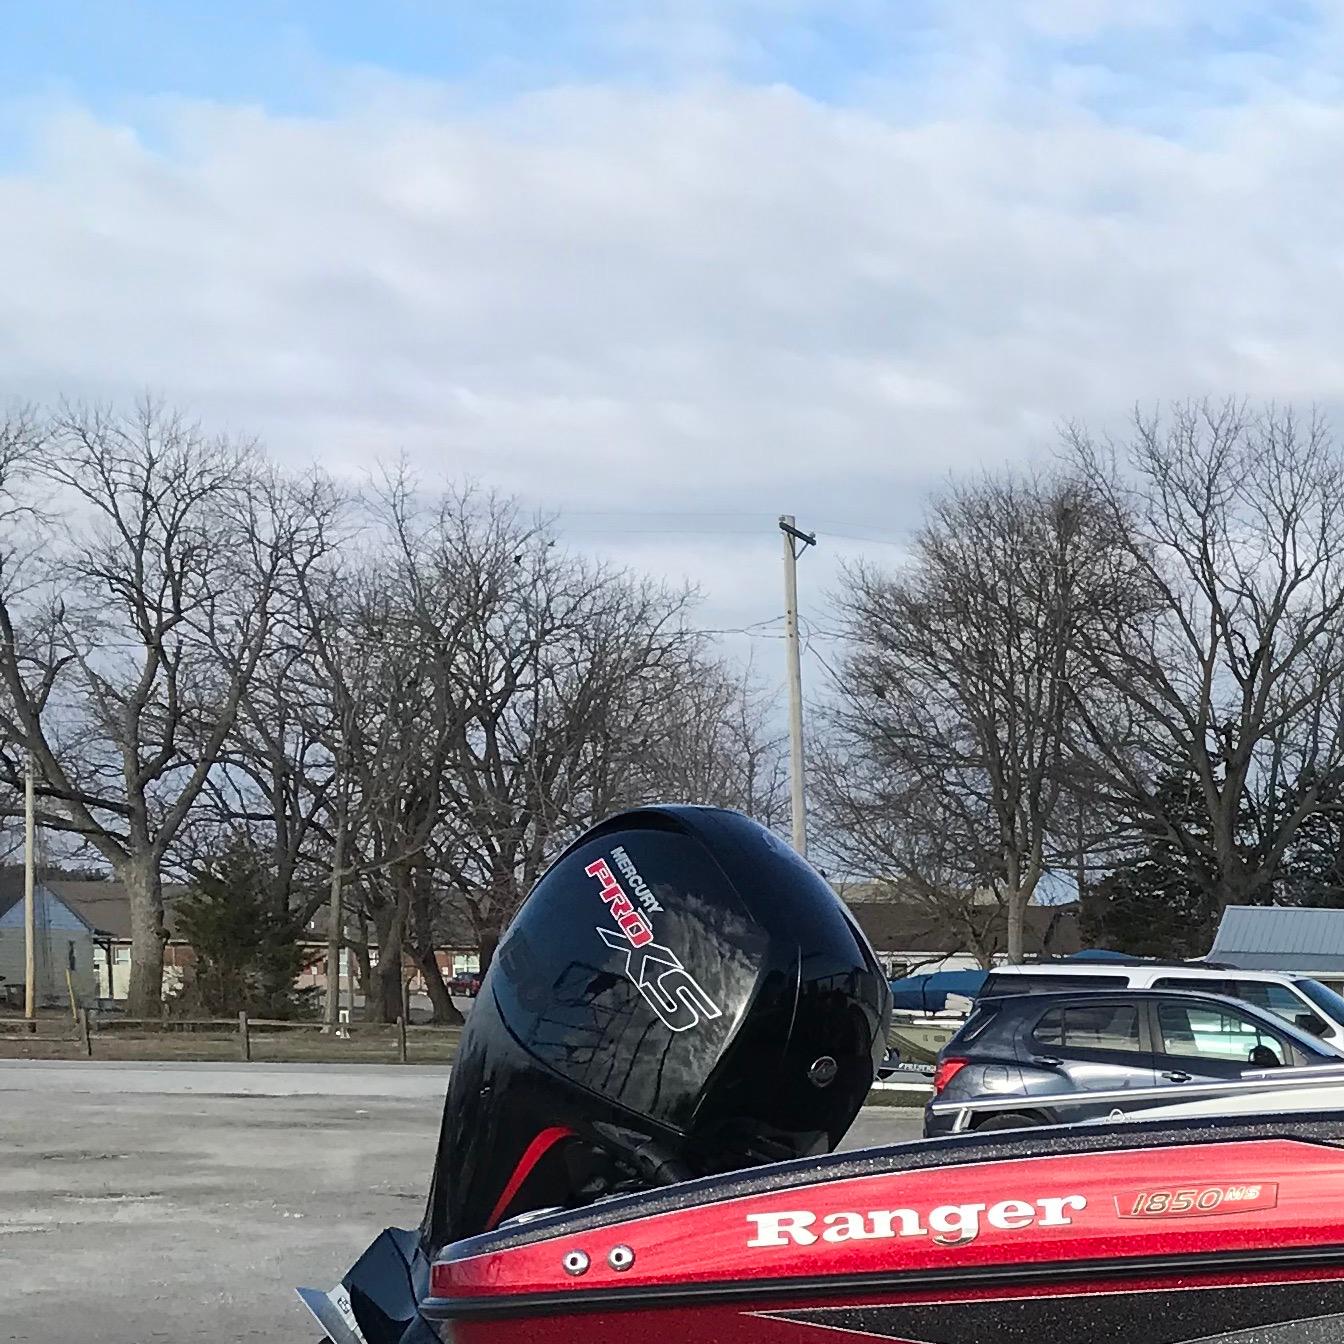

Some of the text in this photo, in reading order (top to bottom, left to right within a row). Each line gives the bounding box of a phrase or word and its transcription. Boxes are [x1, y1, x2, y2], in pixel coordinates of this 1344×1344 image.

[610, 845, 664, 913] MERCURY
[585, 857, 723, 1031] PRO XS
[747, 1194, 1087, 1246] Ranger
